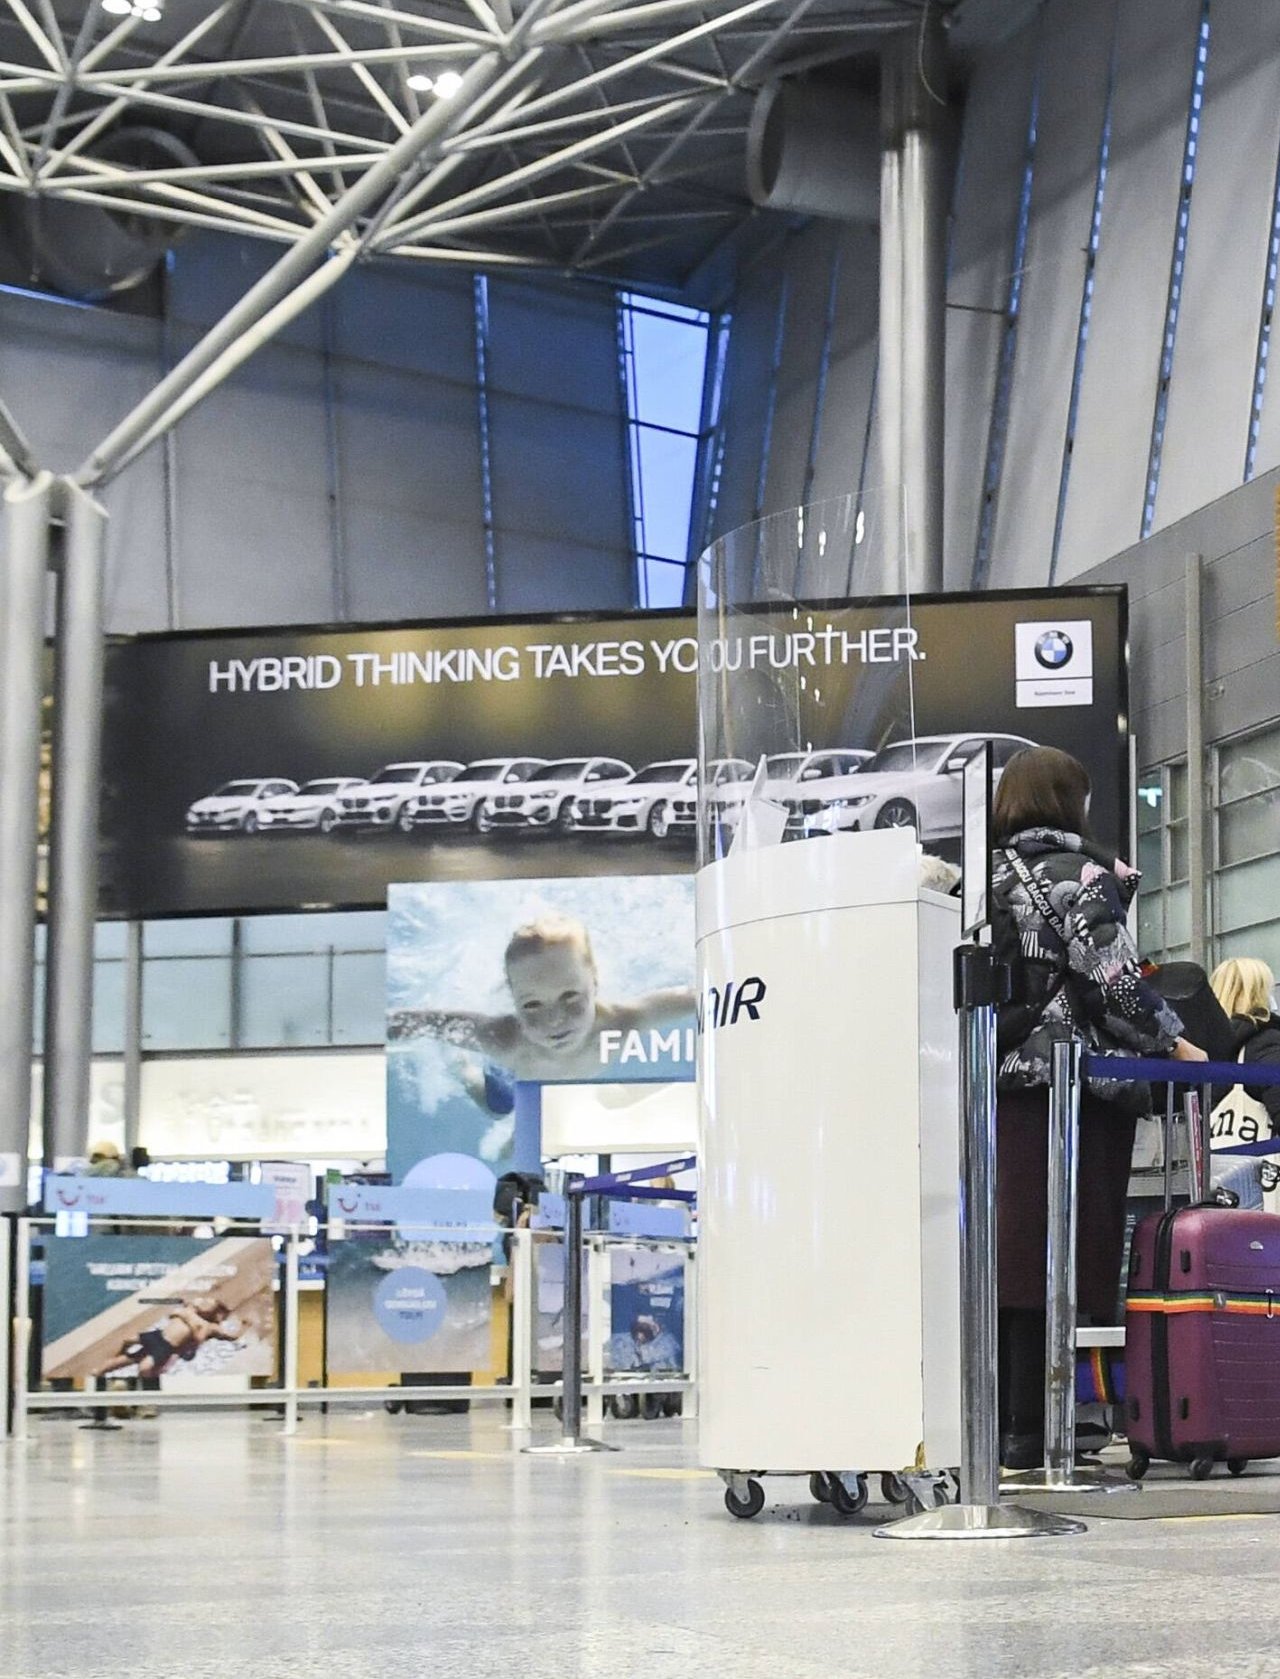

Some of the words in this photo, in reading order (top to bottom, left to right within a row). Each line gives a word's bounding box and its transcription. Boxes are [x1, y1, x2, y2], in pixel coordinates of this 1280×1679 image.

[209, 655, 341, 692] HYBRID
[347, 647, 519, 687] THINKING
[527, 640, 645, 678] TAKES
[750, 627, 926, 668] FURTHER.
[1027, 882, 1053, 916] BAGGU
[599, 1028, 695, 1064] FAMI
